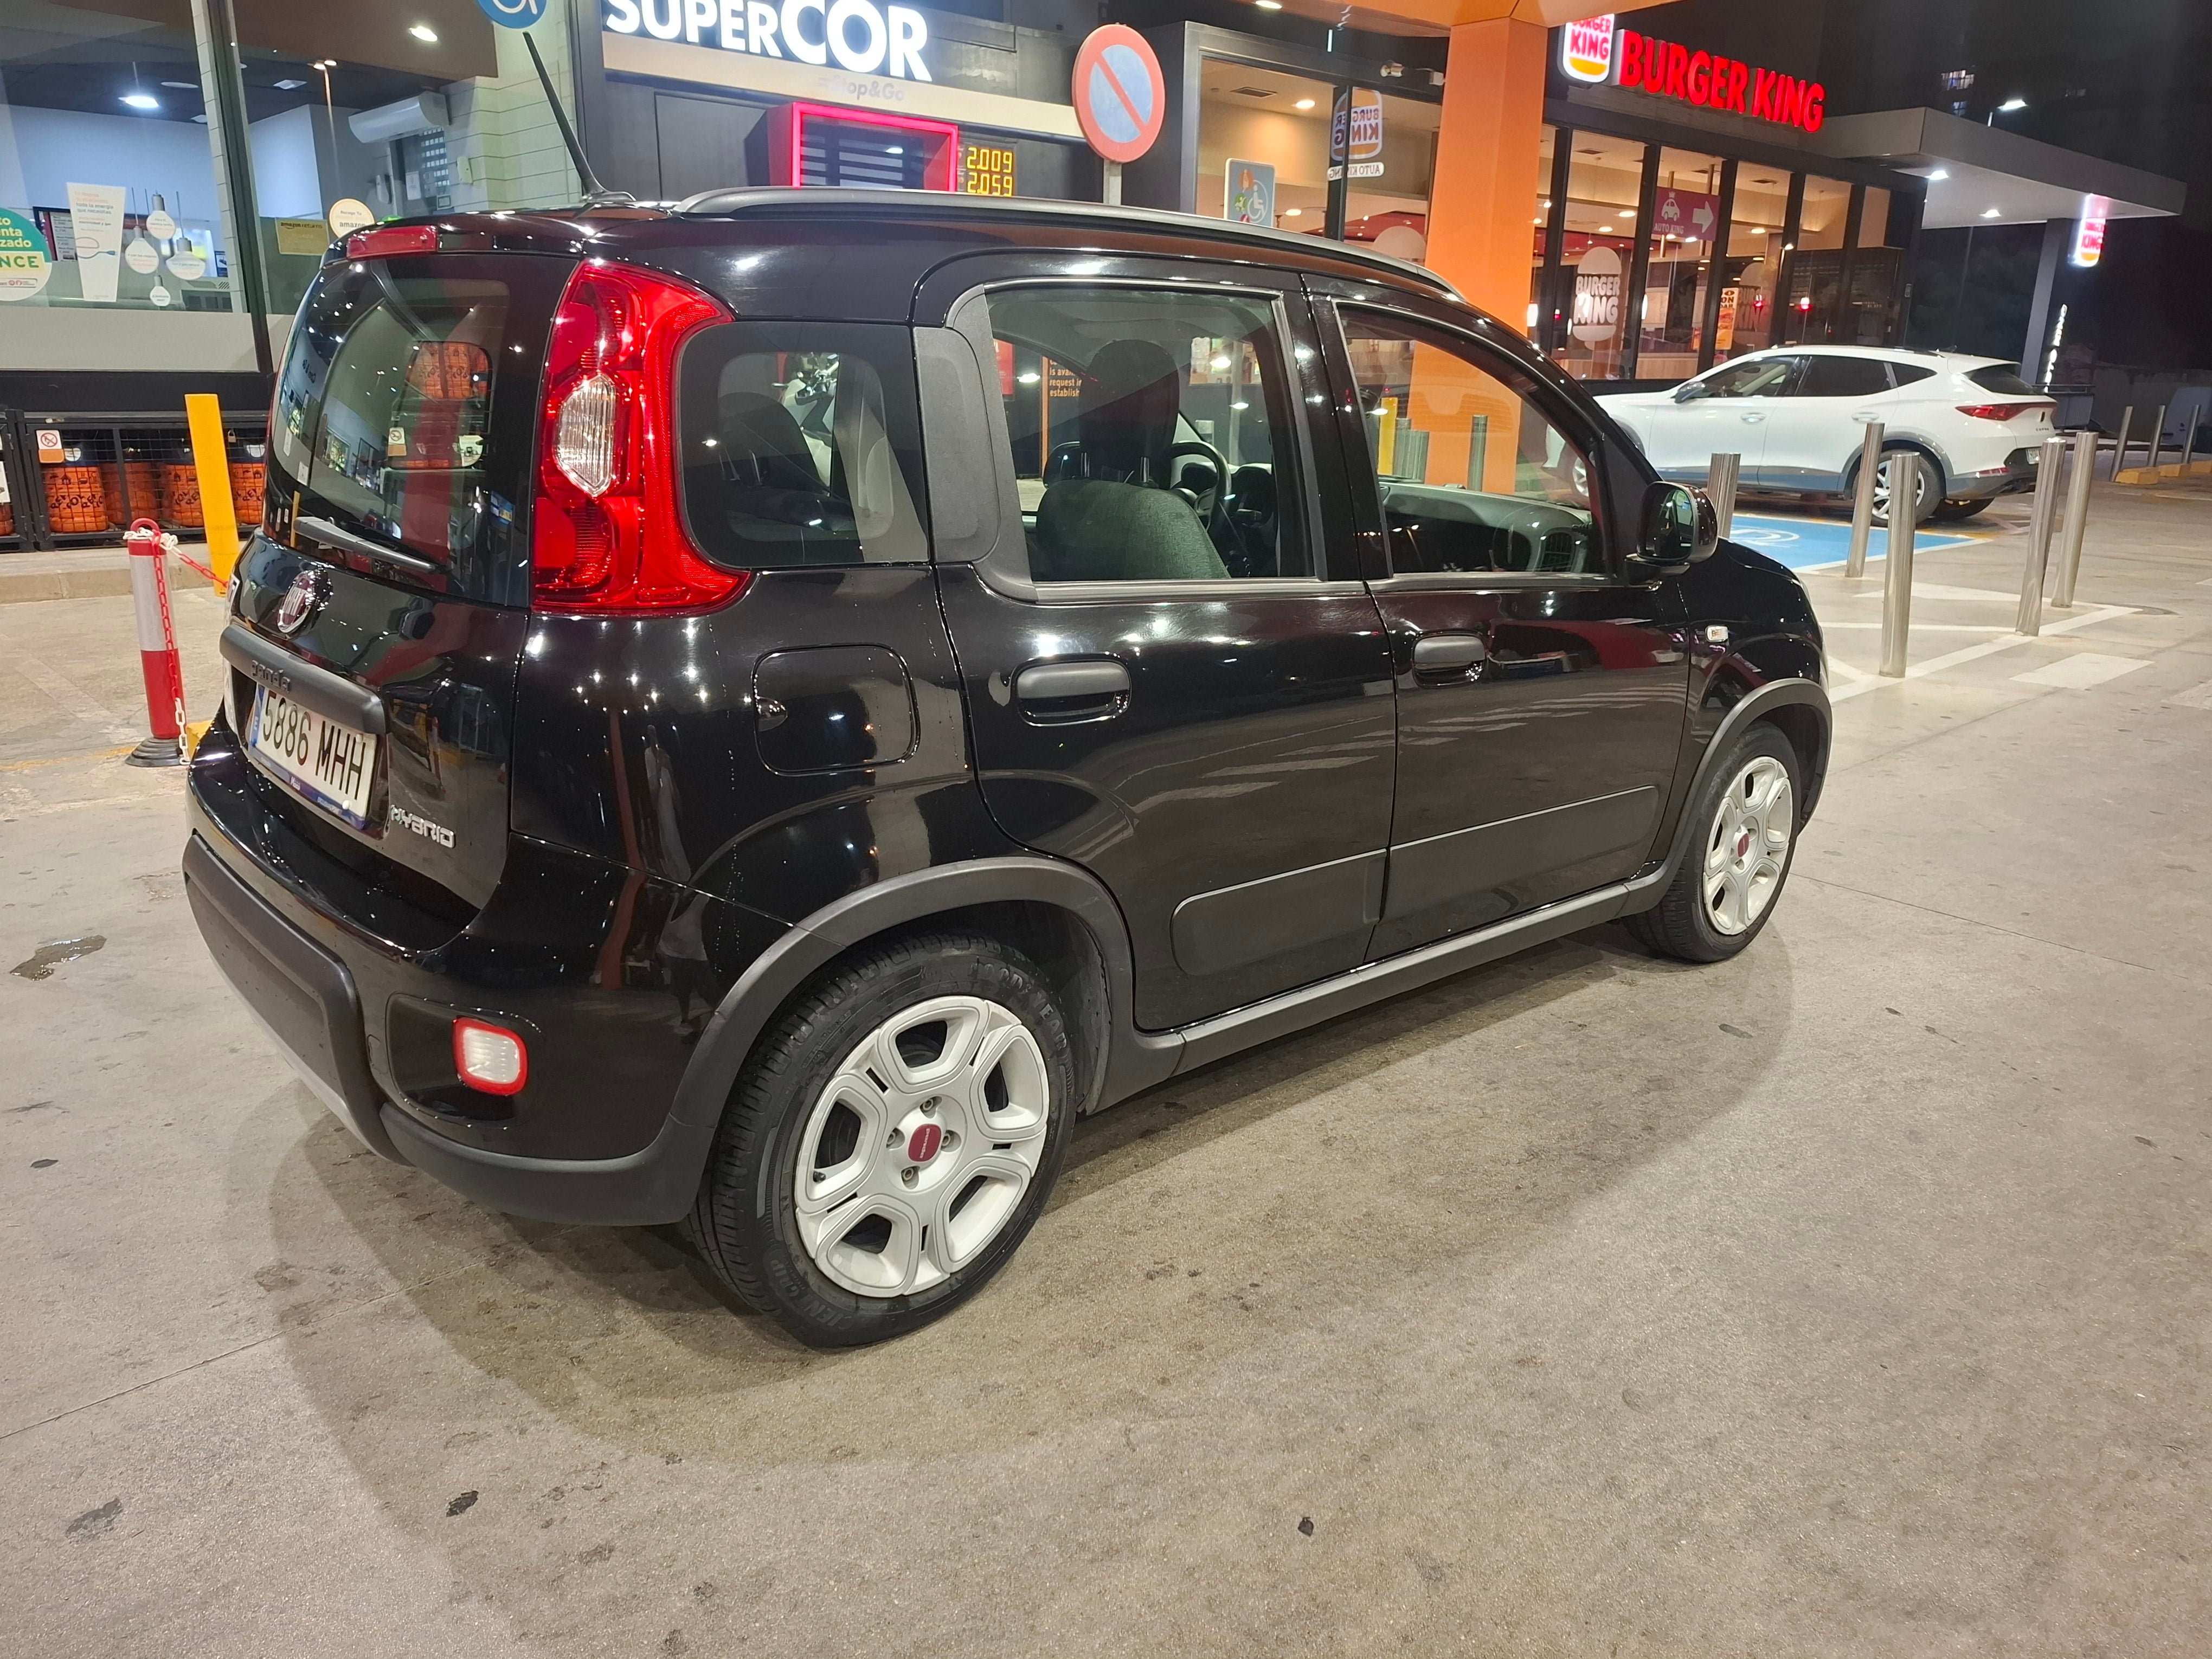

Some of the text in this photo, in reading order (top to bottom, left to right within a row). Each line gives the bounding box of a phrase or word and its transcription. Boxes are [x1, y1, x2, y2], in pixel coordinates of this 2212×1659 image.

[1570, 28, 1609, 60] KING
[1620, 30, 1825, 132] BURGER KING
[967, 147, 1012, 173] 2.009
[967, 172, 1012, 197] 2.059
[1576, 276, 1620, 296] BURGER
[1573, 295, 1618, 324] KING
[1050, 368, 1056, 376] is
[1050, 378, 1075, 389] request
[262, 690, 311, 766] 5886
[315, 720, 366, 800] MHH
[390, 804, 455, 848] HYBRID
[919, 1128, 930, 1159] panda
